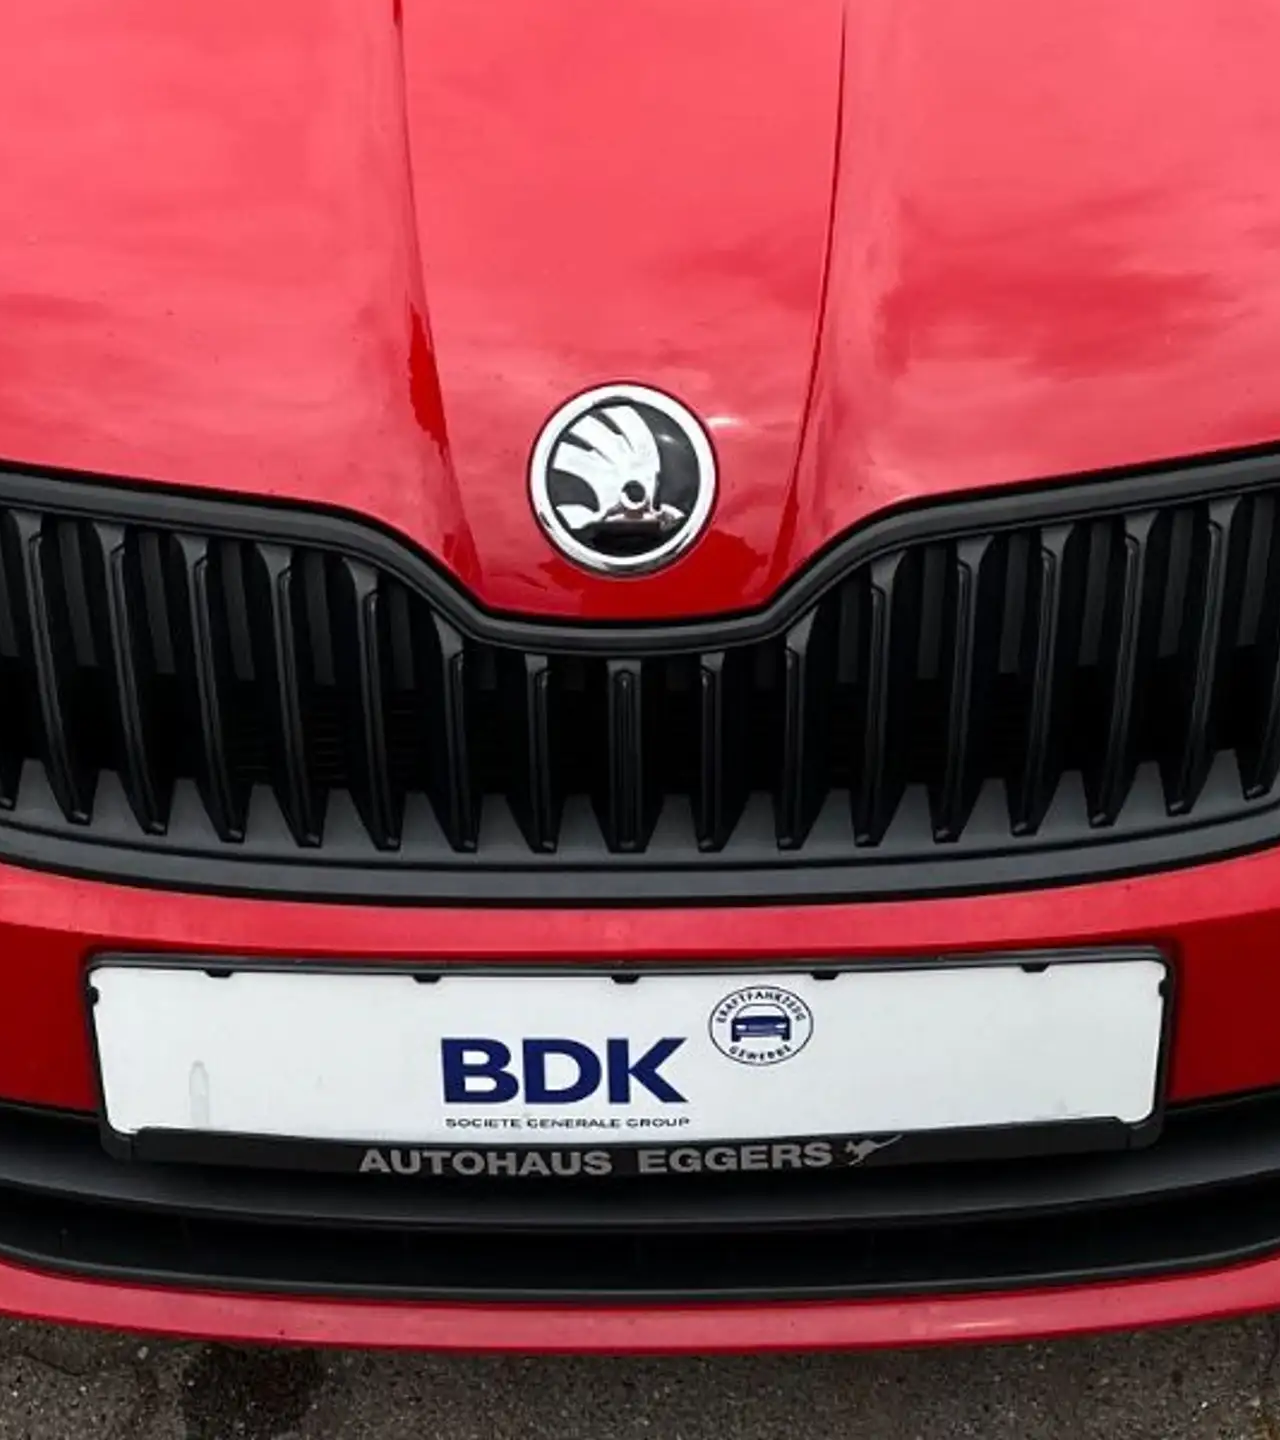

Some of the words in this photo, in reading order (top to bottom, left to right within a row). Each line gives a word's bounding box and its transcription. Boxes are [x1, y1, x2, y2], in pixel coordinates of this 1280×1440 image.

[441, 1037, 689, 1104] BDK
[445, 1117, 519, 1129] SOCIETE
[526, 1117, 622, 1129] GENERALE
[626, 1116, 691, 1129] GROUP
[359, 1149, 613, 1176] AUTOHAUS
[637, 1142, 833, 1173] EGGERS
